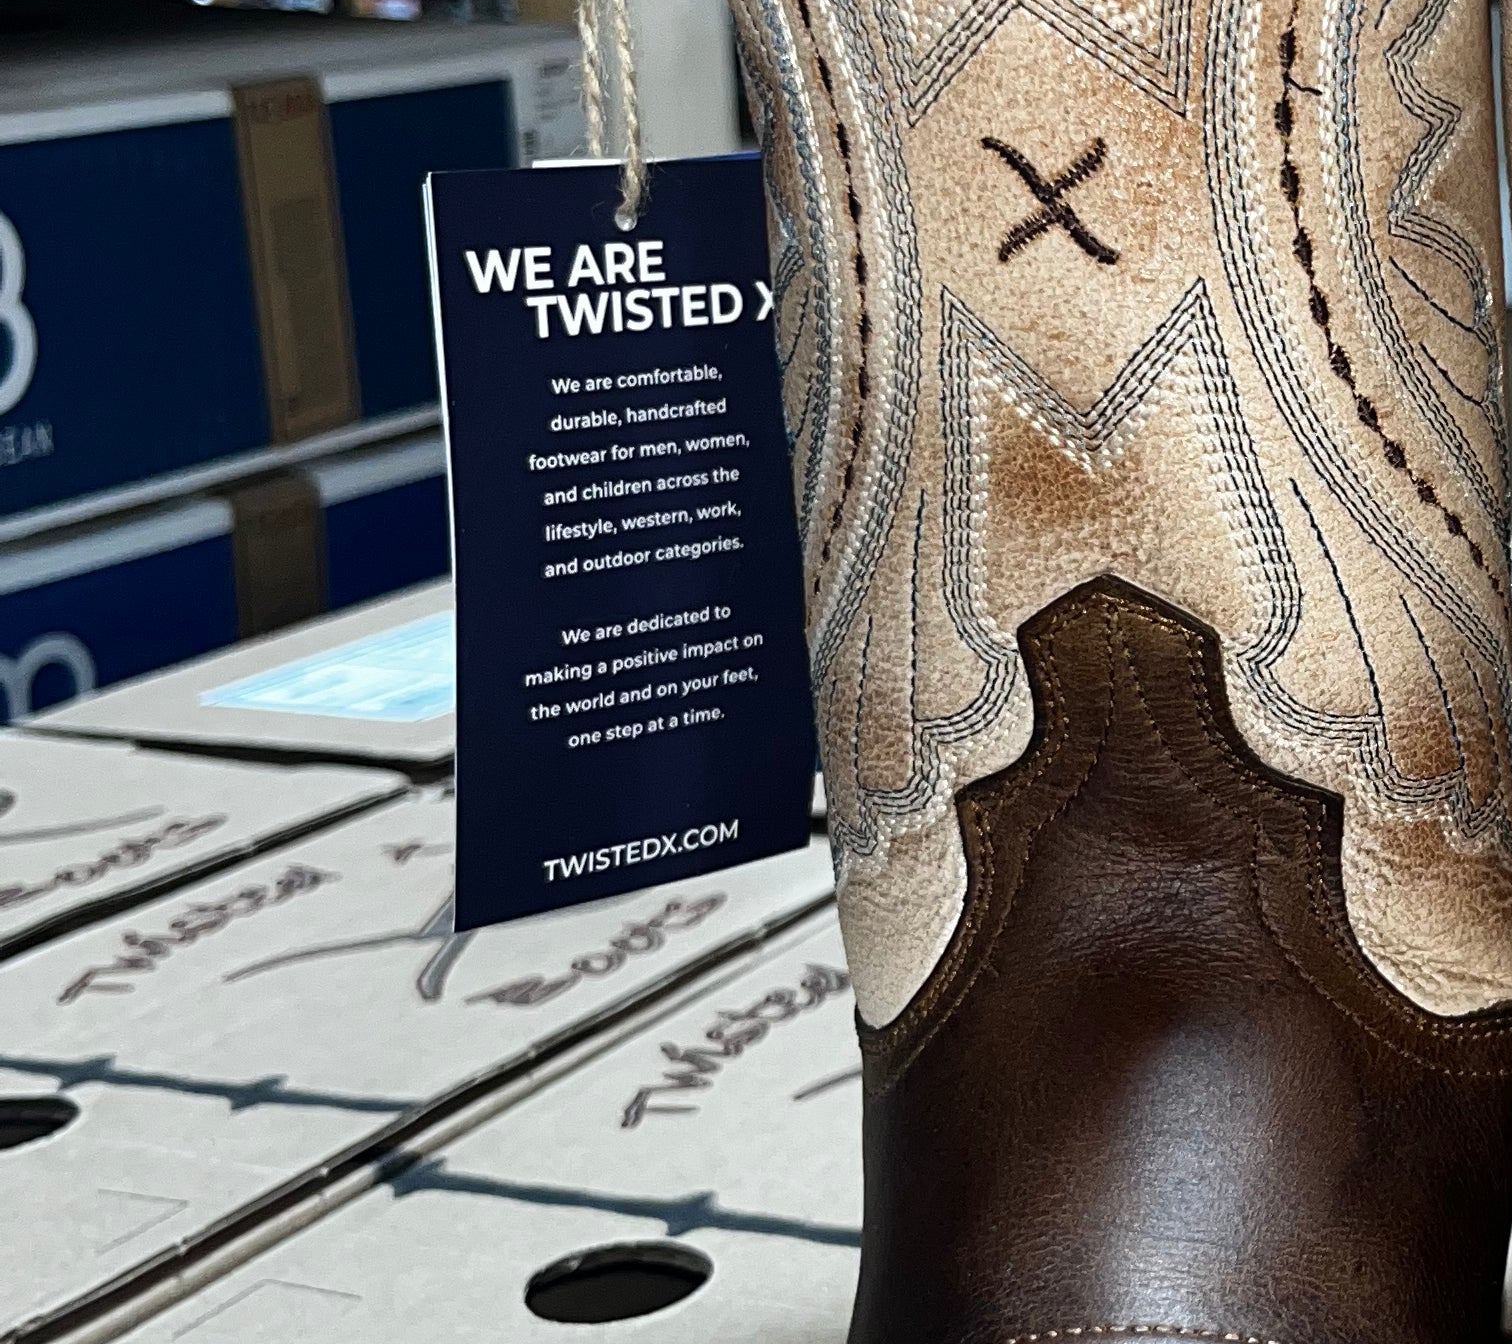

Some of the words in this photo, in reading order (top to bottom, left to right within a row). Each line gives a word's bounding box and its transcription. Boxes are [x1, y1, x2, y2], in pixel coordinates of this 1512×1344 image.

[466, 247, 554, 293] WE
[568, 241, 665, 287] ARE
[526, 283, 744, 338] TWISTED
[552, 378, 580, 394] We
[586, 377, 612, 391] are
[617, 365, 722, 388] comfortable,
[551, 410, 622, 431] durable,
[627, 398, 726, 423] handcrafted
[529, 450, 606, 470] footwear
[611, 445, 635, 460] for
[640, 442, 681, 457] men,
[686, 434, 749, 451] women,
[544, 486, 577, 505] and
[583, 480, 651, 500] children
[657, 473, 708, 490] across
[713, 467, 739, 482] the
[546, 519, 617, 541] lifestyle,
[622, 511, 693, 530] western,
[697, 501, 741, 519] work,
[545, 558, 577, 577] and
[583, 551, 651, 571] outdoor
[655, 536, 743, 560] categories.
[562, 629, 590, 644] We
[596, 625, 622, 639] are
[627, 607, 709, 634] dedicated
[715, 607, 730, 619] to
[526, 664, 592, 686] making
[598, 662, 607, 673] a
[613, 649, 678, 674] positive
[683, 637, 738, 658] impact
[744, 635, 762, 647] on
[531, 704, 560, 720] the
[566, 691, 614, 713] world
[620, 684, 651, 703] and
[657, 683, 677, 696] on
[683, 675, 718, 696] your
[723, 668, 758, 684] feet,
[569, 731, 601, 747] one
[606, 722, 643, 743] step
[648, 718, 664, 732] at
[669, 717, 678, 727] a
[684, 708, 724, 725] time.
[544, 819, 740, 881] TWISTEDX.COM
